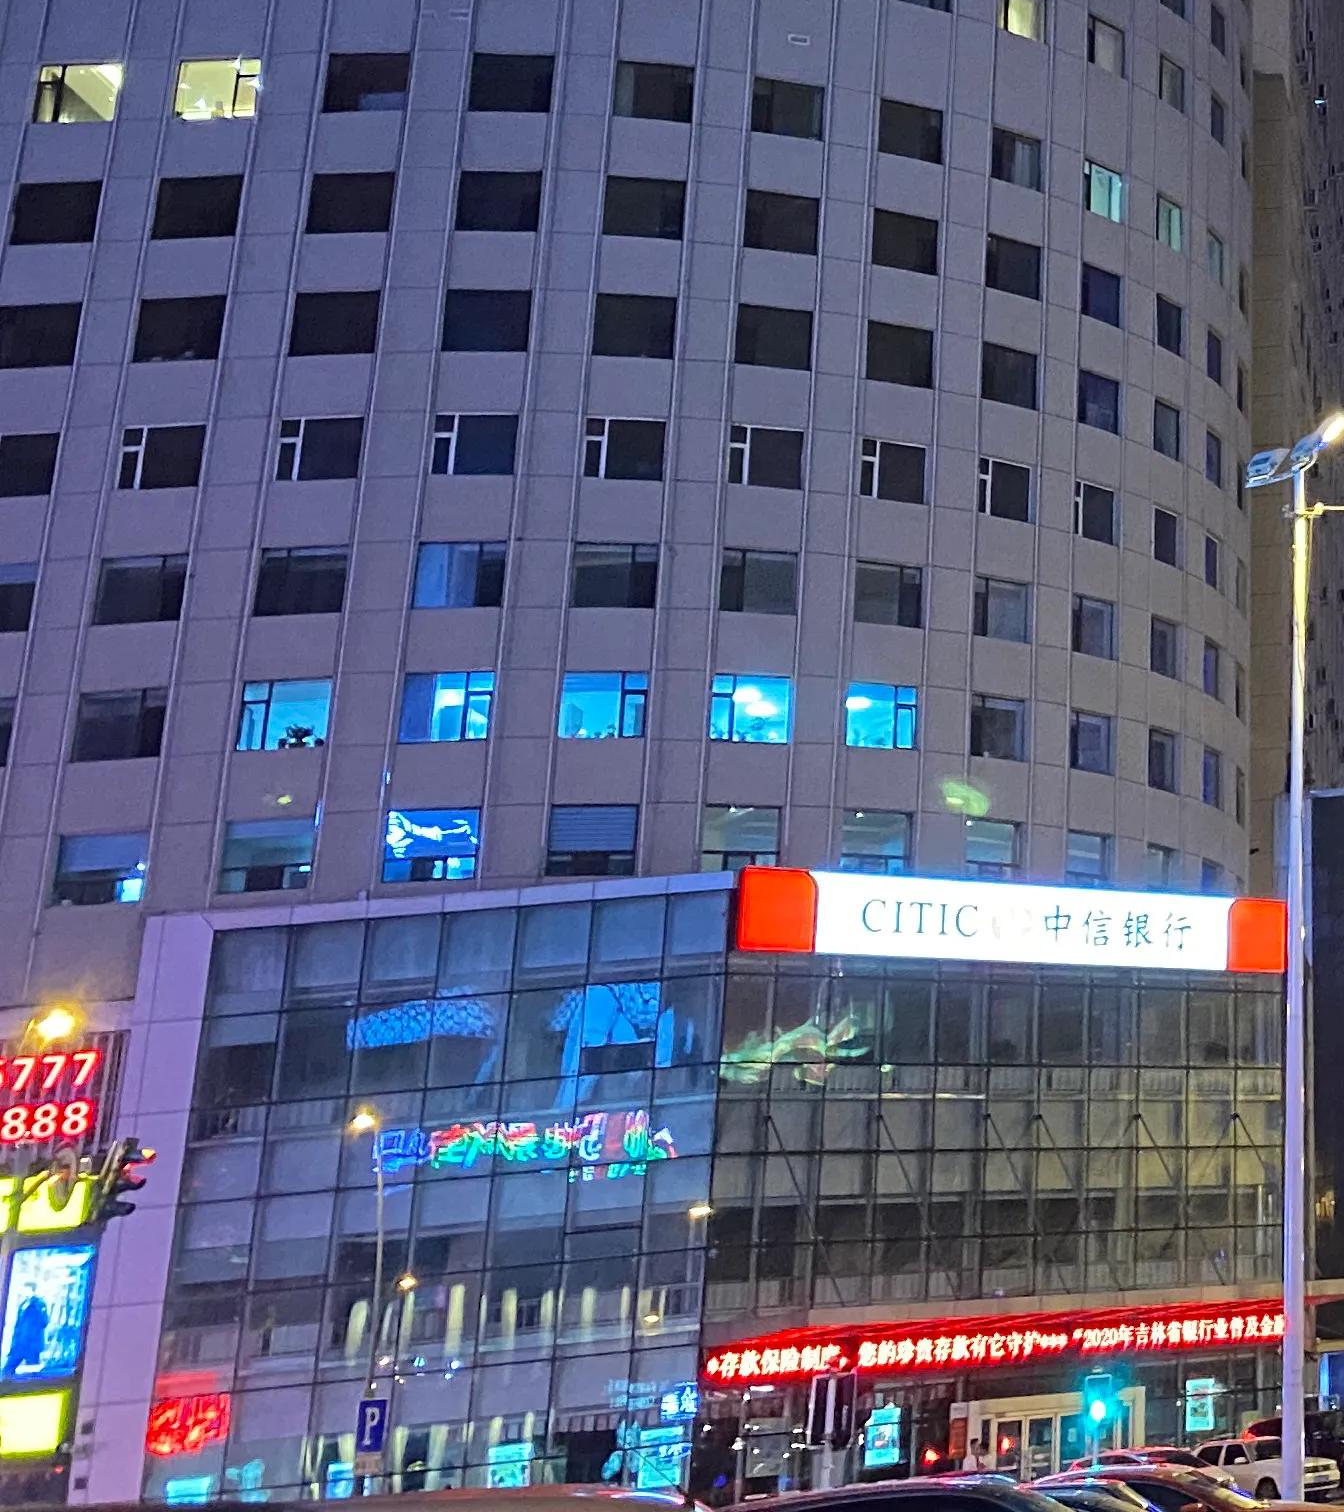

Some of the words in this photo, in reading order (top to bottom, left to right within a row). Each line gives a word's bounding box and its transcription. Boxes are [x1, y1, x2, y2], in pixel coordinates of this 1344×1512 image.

[861, 899, 979, 938] CITIC
[1044, 904, 1192, 951] 中信银行
